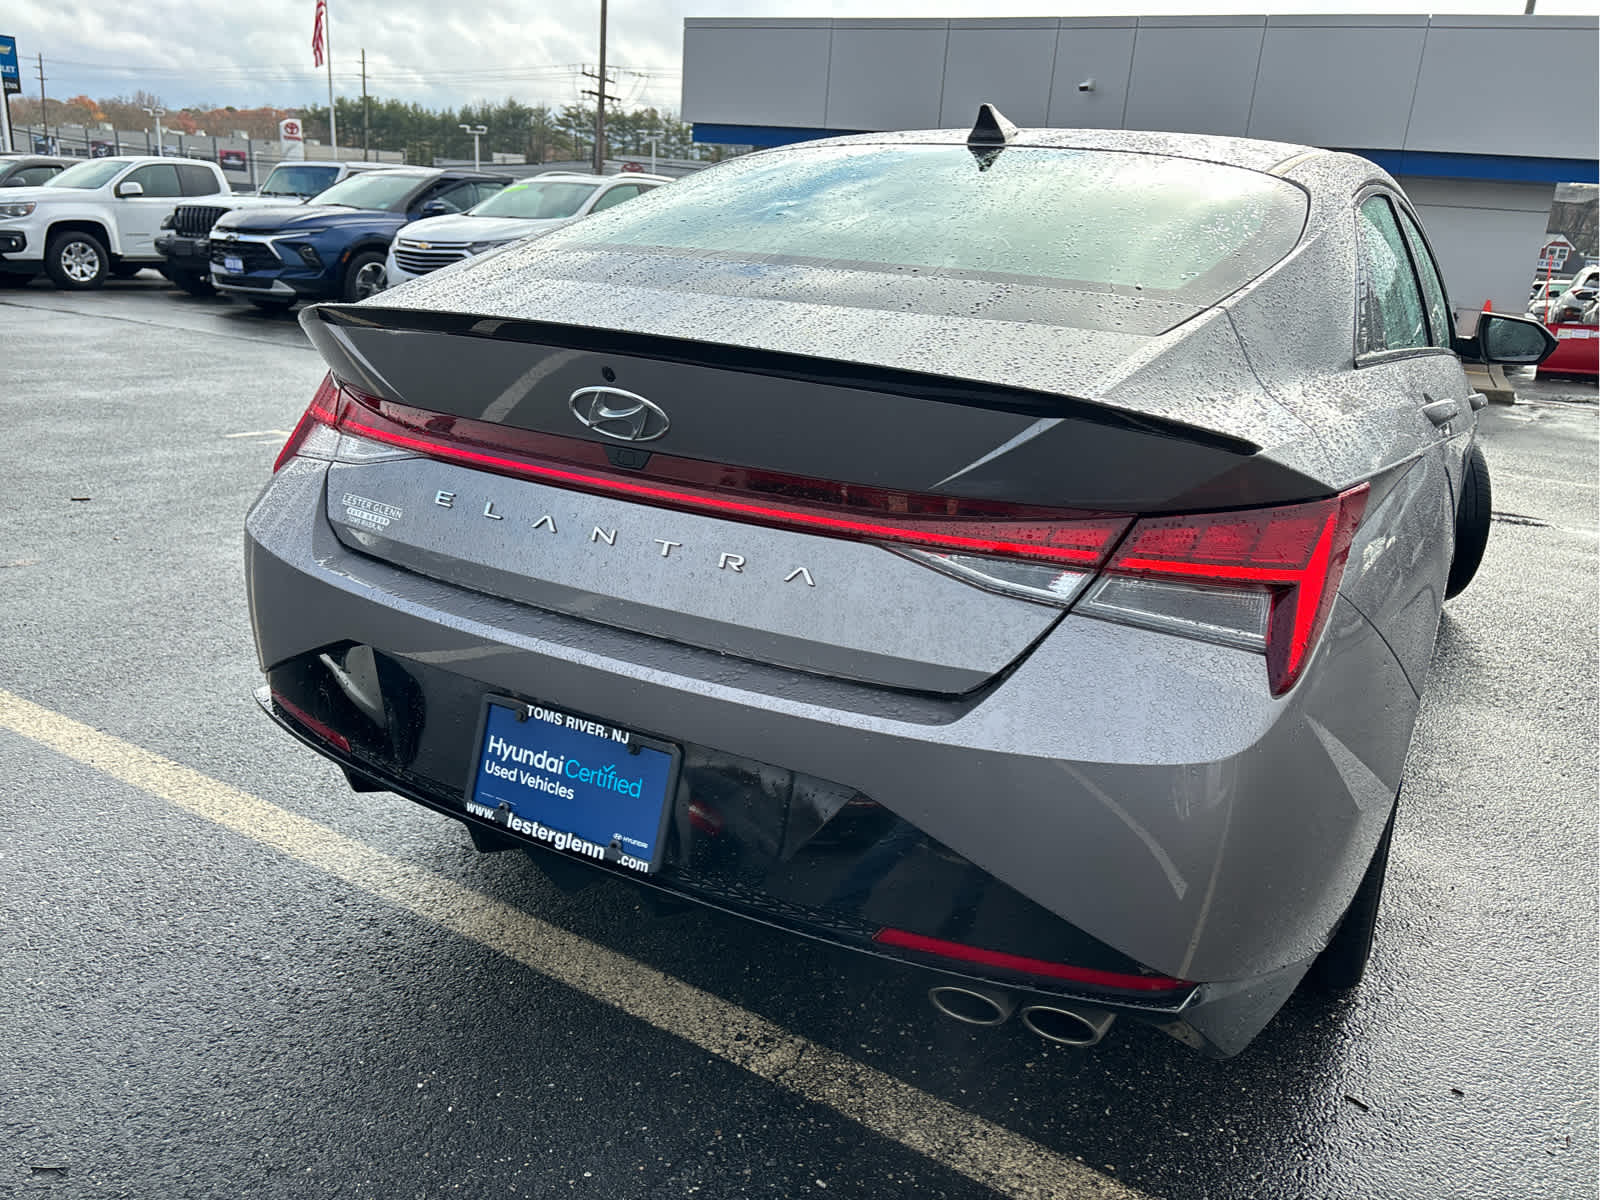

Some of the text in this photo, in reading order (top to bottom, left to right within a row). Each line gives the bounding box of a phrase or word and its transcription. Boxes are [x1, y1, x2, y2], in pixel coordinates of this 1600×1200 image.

[342, 494, 402, 519] LESTER GLENN
[434, 489, 816, 588] ELANTRA
[527, 704, 630, 745] TOMS RIVER, NJ
[485, 759, 575, 800] Used Vehicles
[488, 735, 643, 799] Hyundai Certified
[466, 801, 649, 873] www. lesterglenn .com
